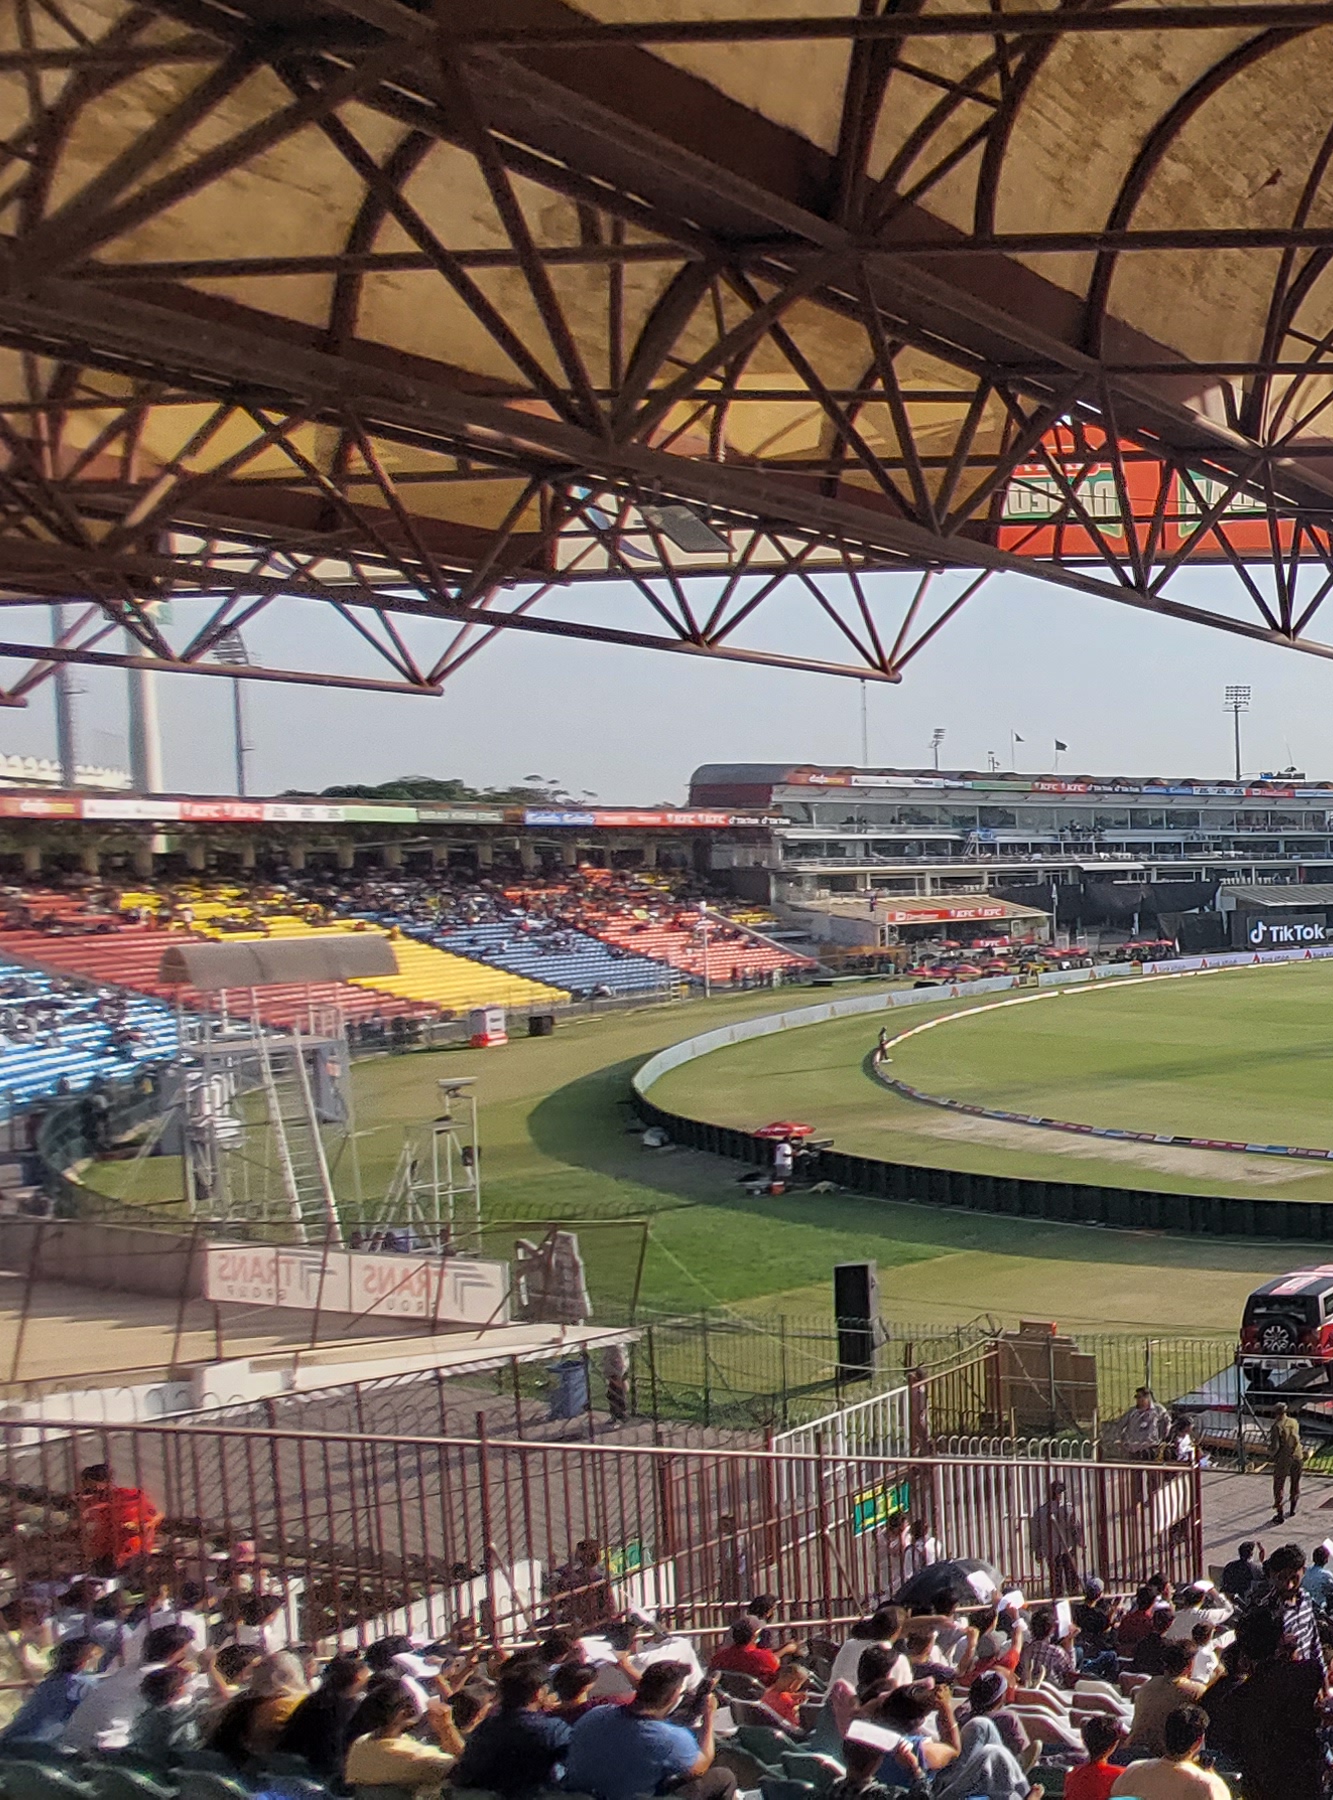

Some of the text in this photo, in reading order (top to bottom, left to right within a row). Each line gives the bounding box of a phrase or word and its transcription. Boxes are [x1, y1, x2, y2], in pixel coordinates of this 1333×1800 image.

[1040, 782, 1083, 791] KFC KFC
[956, 907, 1002, 918] KFC KFC
[1269, 923, 1326, 942] TikTok
